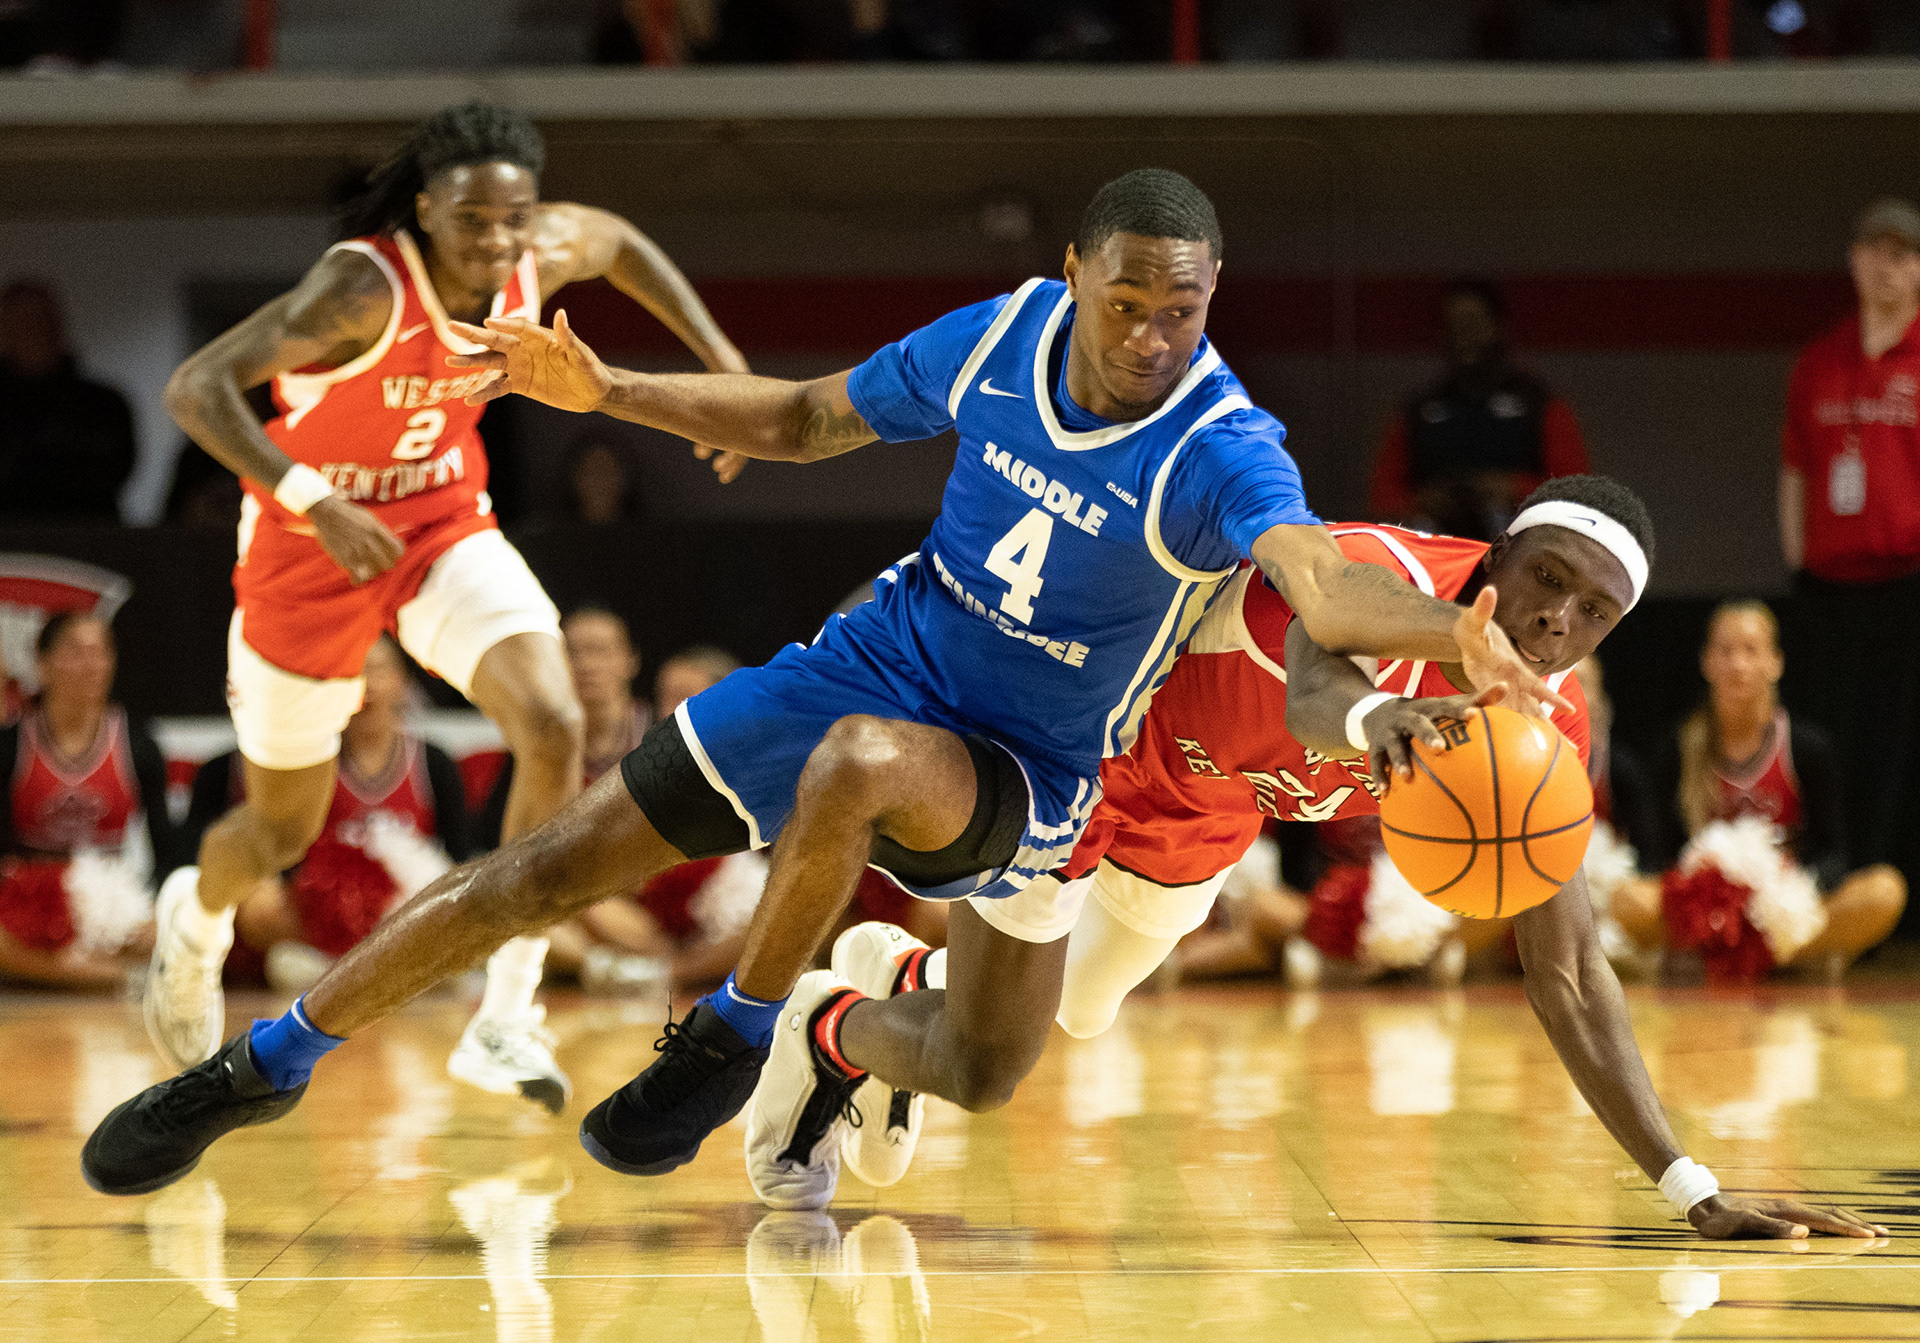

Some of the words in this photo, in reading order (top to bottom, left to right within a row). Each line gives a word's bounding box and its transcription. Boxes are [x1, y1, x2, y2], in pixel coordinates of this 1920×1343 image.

[391, 407, 448, 461] 2
[983, 441, 1109, 538] MIDDLE
[983, 507, 1054, 626] 4
